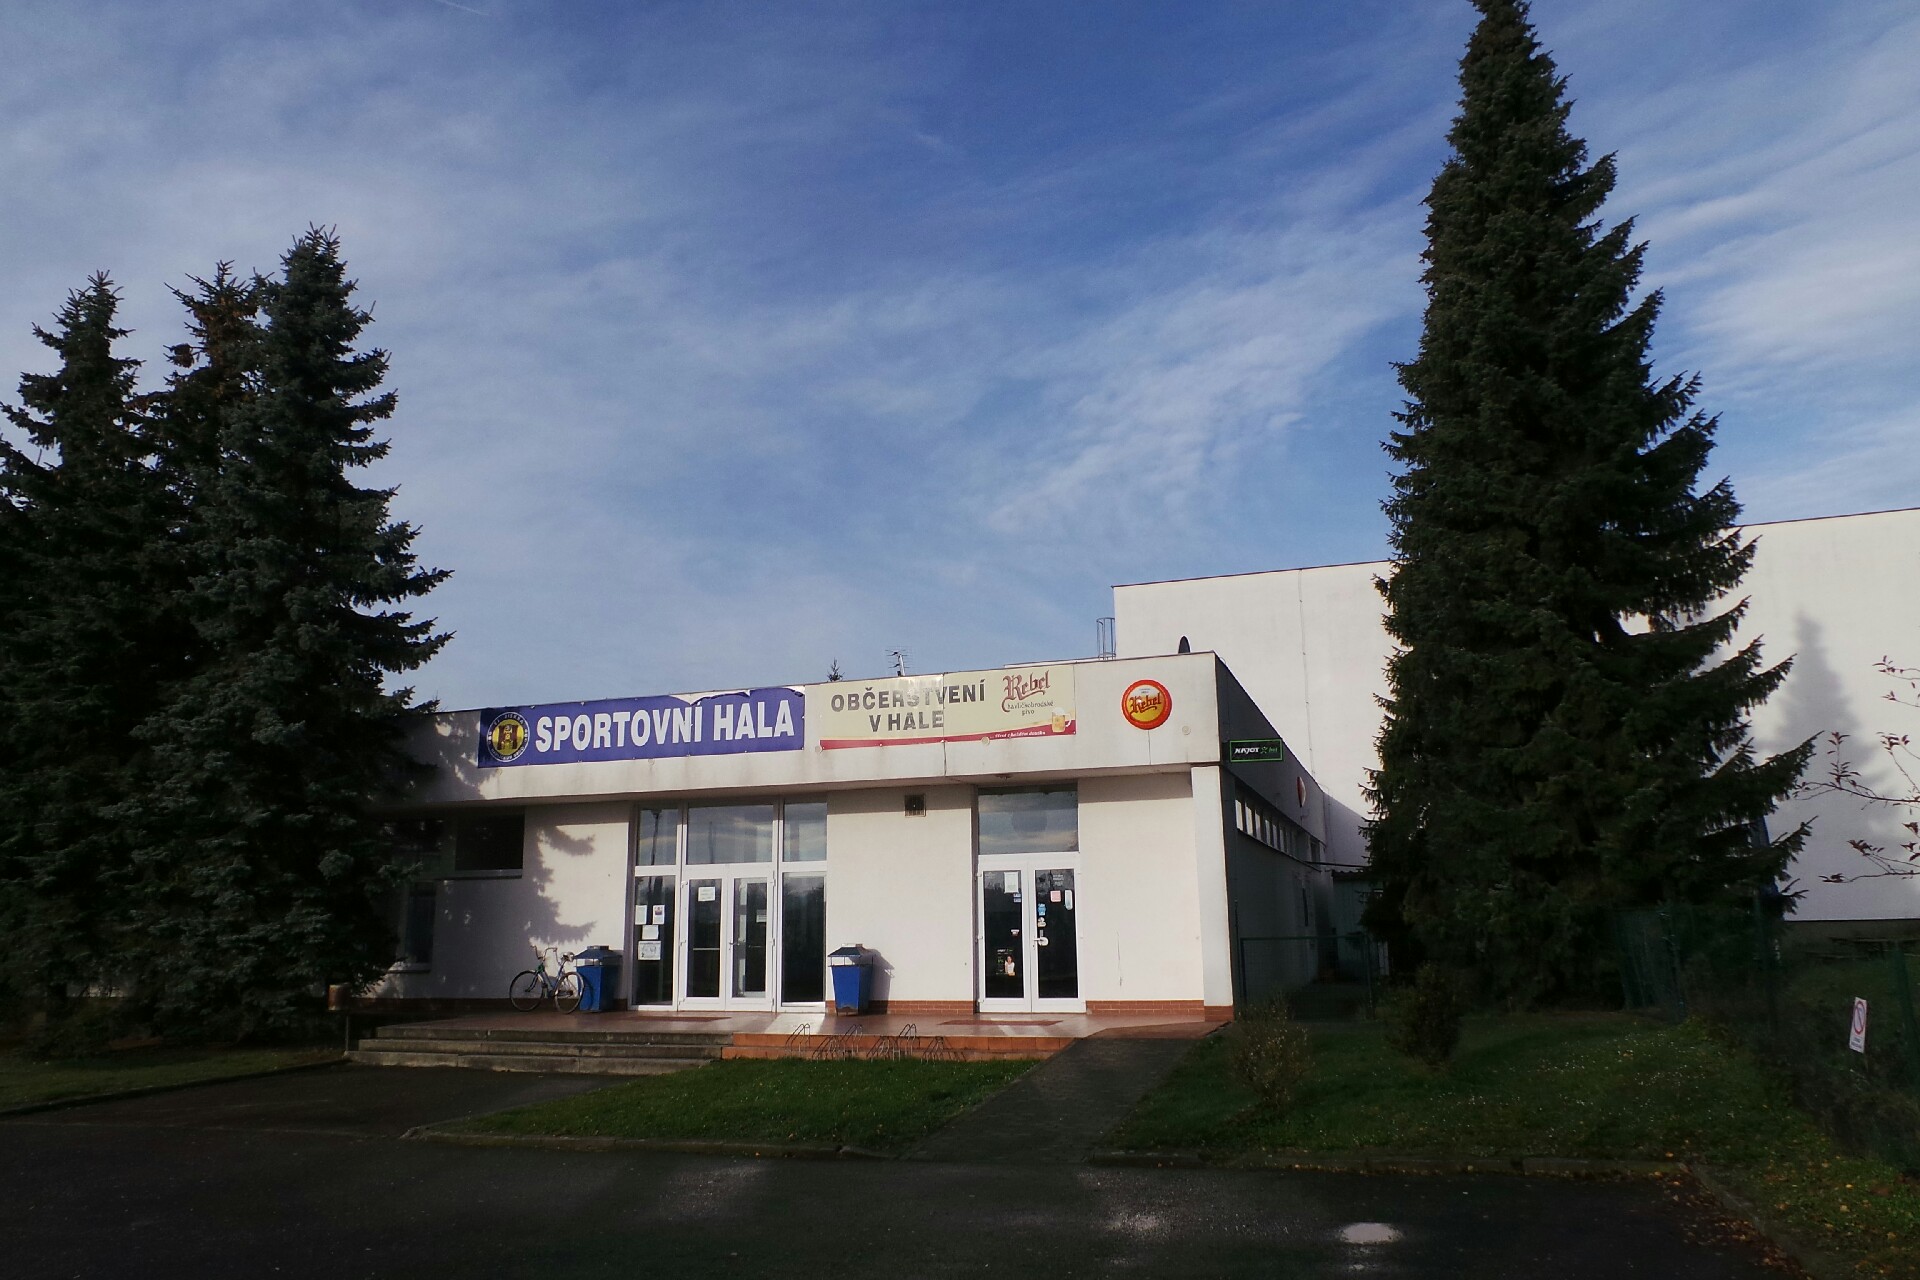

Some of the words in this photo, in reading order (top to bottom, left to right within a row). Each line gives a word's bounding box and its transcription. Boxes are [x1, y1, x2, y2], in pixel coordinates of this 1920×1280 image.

[831, 679, 985, 713] OBČERSTVENÍ
[1002, 669, 1051, 712] Rebel
[1129, 691, 1162, 716] Rebel
[535, 705, 702, 753] SPORTOVNÍ
[713, 699, 795, 741] HALA
[869, 714, 882, 732] V
[888, 710, 944, 731] HALE
